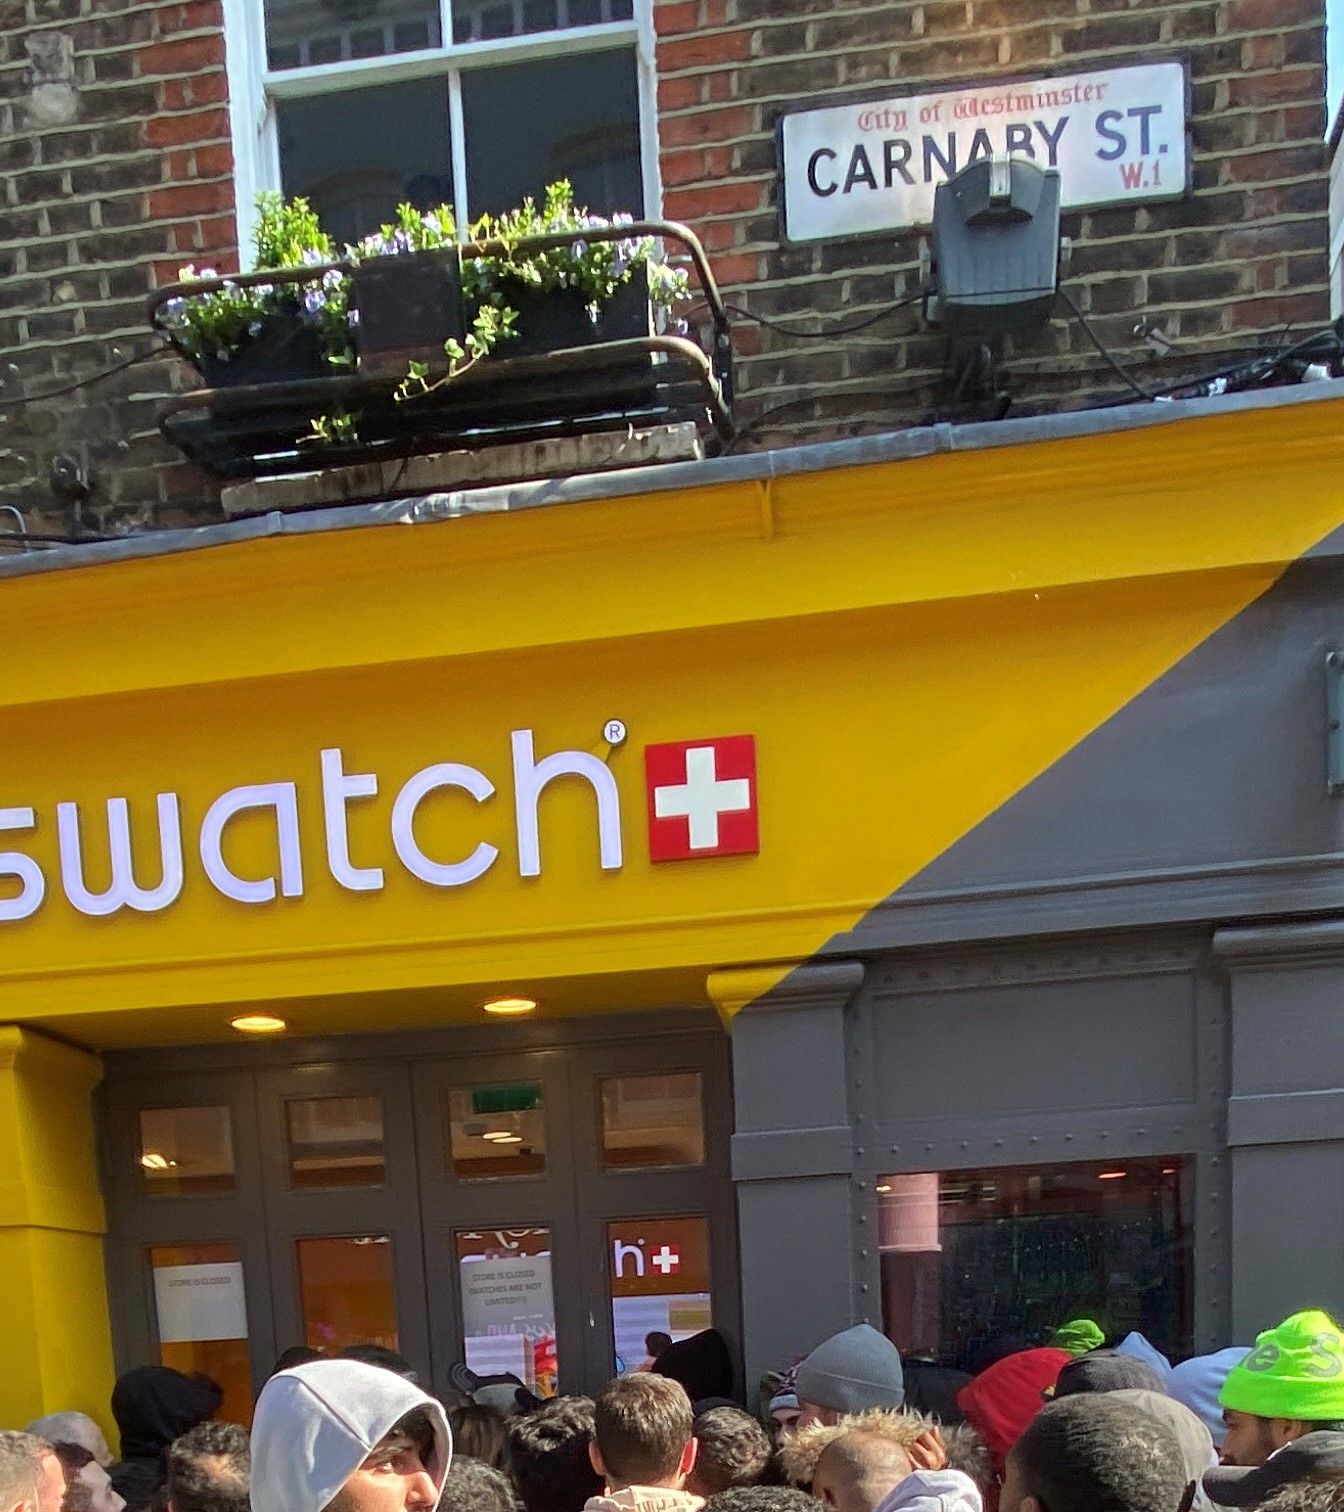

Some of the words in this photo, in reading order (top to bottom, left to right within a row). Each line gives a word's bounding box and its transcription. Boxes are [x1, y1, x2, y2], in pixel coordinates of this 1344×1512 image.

[857, 109, 910, 133] City
[919, 101, 943, 124] of
[952, 80, 1110, 118] Westminster
[1095, 104, 1168, 160] ST.
